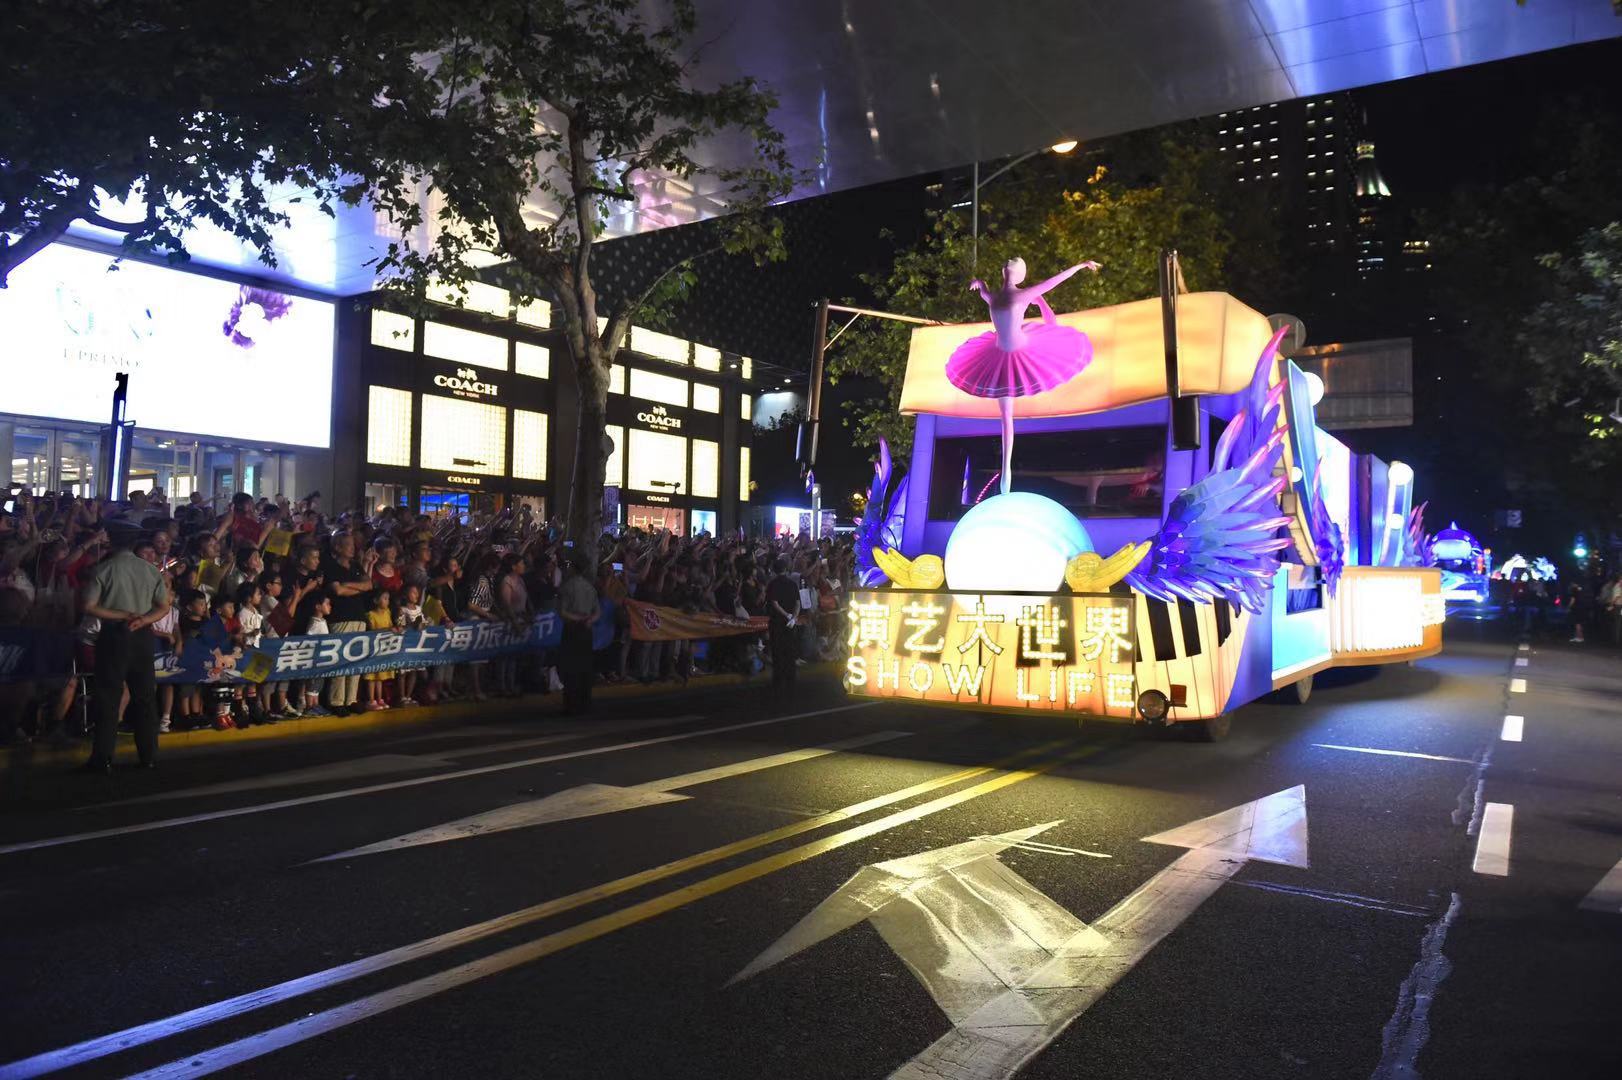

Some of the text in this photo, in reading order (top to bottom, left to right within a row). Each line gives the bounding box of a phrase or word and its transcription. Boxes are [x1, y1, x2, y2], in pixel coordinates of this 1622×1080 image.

[433, 374, 498, 396] COACH
[637, 412, 681, 428] COACH
[447, 475, 480, 485] COACH
[646, 495, 670, 503] COACH
[847, 599, 1133, 663] 演艺大世界
[847, 655, 1135, 708] SHOW LIFE
